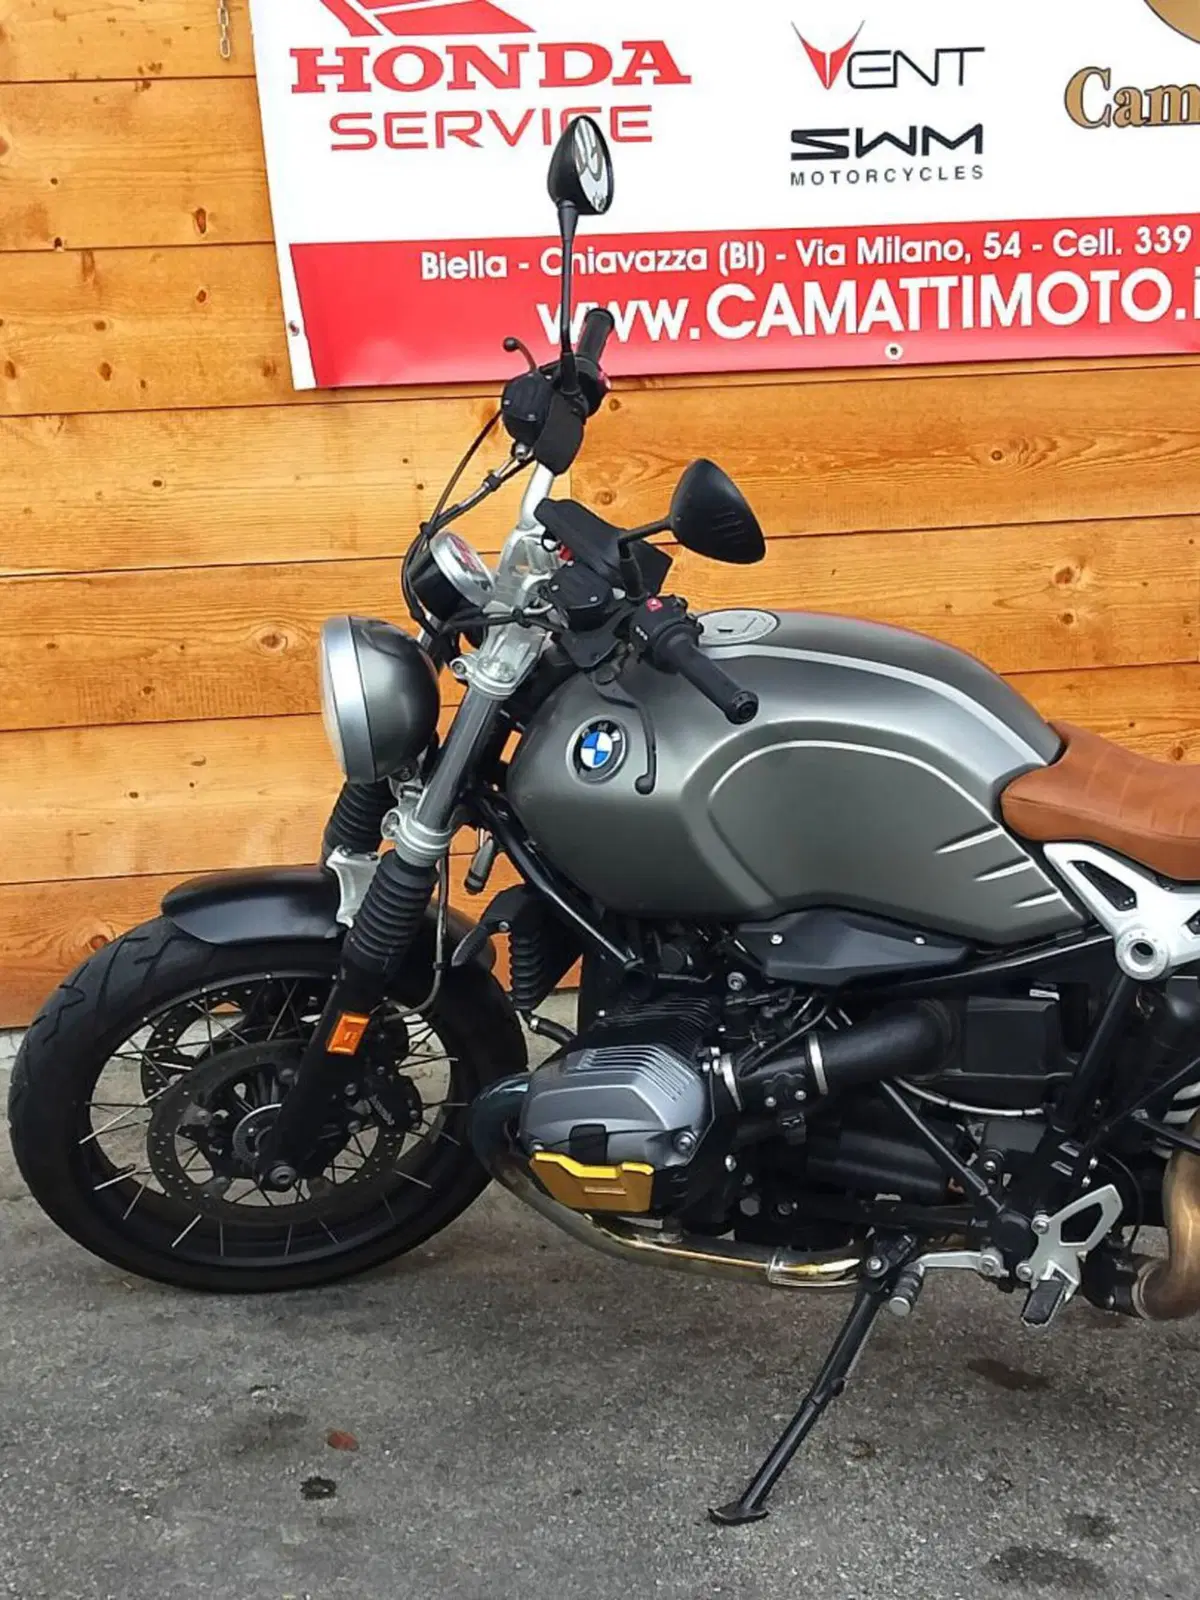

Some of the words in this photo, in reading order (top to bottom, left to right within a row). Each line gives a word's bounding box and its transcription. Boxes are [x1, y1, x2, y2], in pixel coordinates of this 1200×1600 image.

[289, 40, 692, 94] HONDA
[791, 19, 986, 90] VENT
[1063, 66, 1200, 129] Cam
[790, 123, 983, 161] SWM
[790, 164, 983, 186] MOTORCYCLES
[421, 250, 508, 280] Biella
[540, 246, 708, 277] Chiavazza
[718, 241, 765, 276] (BI)
[796, 239, 846, 267] Via
[857, 231, 971, 265] Milano,
[982, 230, 1022, 260] 54
[1052, 227, 1122, 258] Cell.
[1134, 224, 1192, 255] 339
